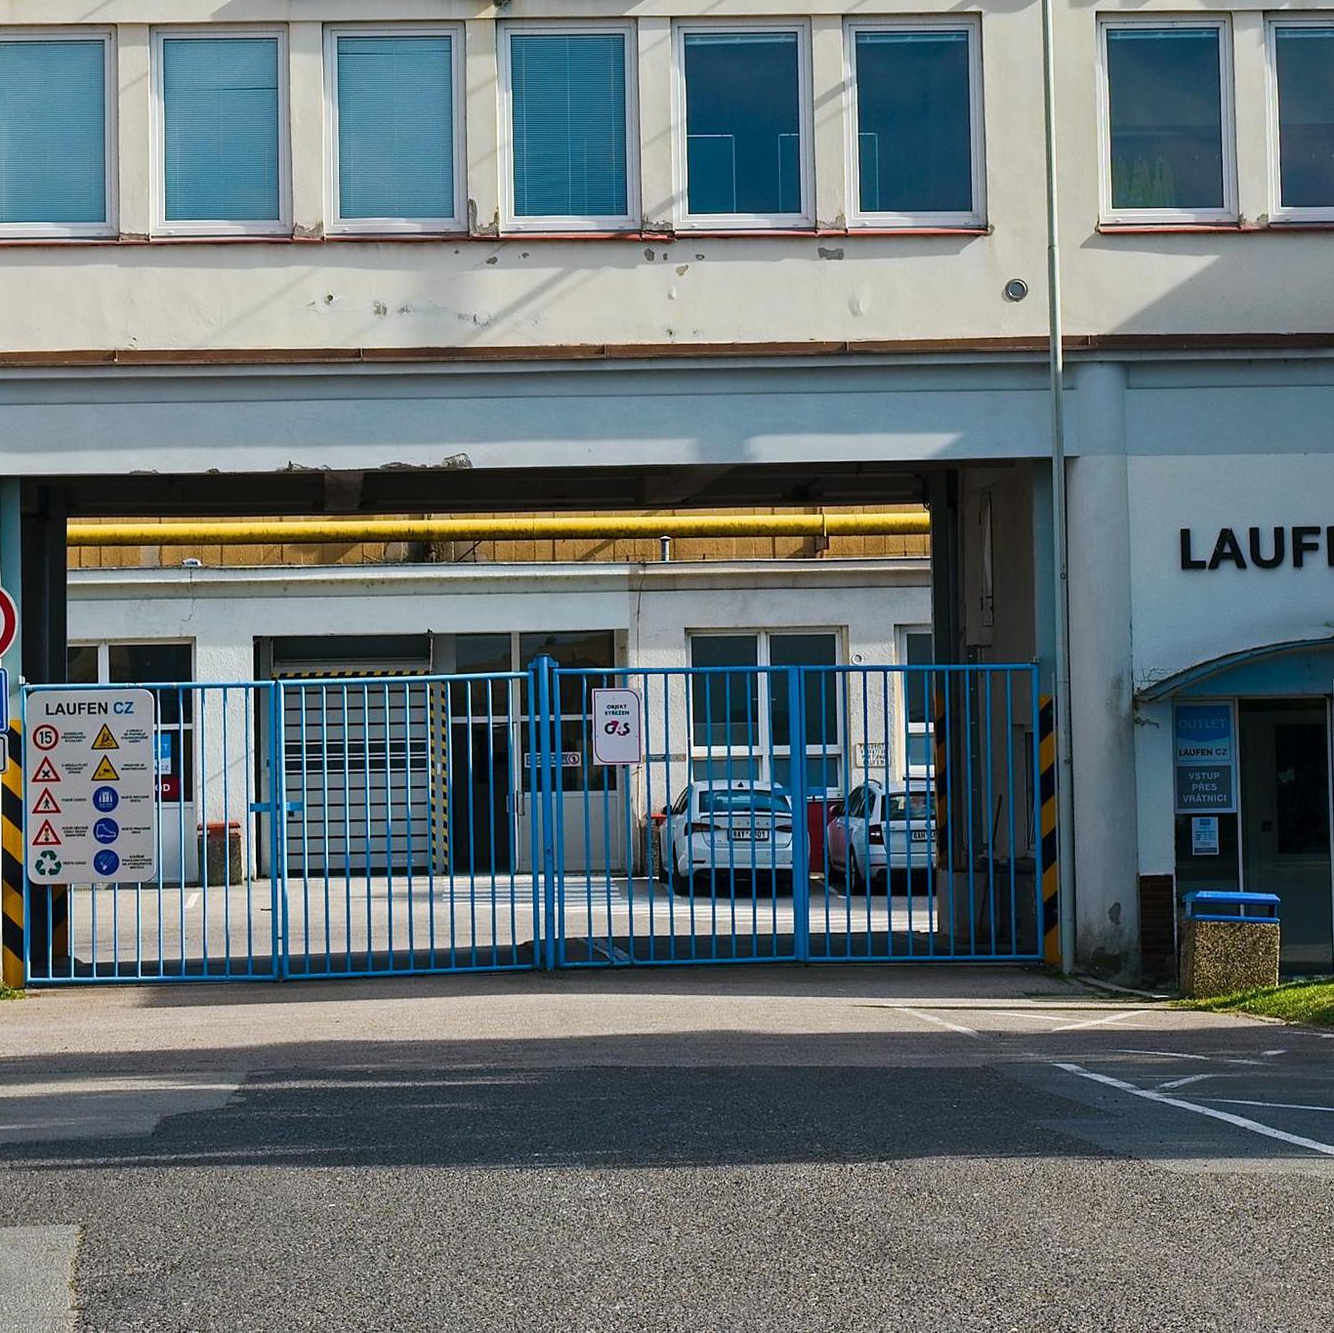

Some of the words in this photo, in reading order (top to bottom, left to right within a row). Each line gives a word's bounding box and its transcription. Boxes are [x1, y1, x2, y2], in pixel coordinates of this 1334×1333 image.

[46, 702, 108, 716] LAUFEN
[113, 701, 135, 715] CZ
[1179, 718, 1228, 730] OUTLET
[39, 731, 53, 744] 15
[1179, 748, 1213, 756] LAUFEN
[1215, 748, 1228, 756] CZ
[1189, 771, 1220, 780] VSTUP
